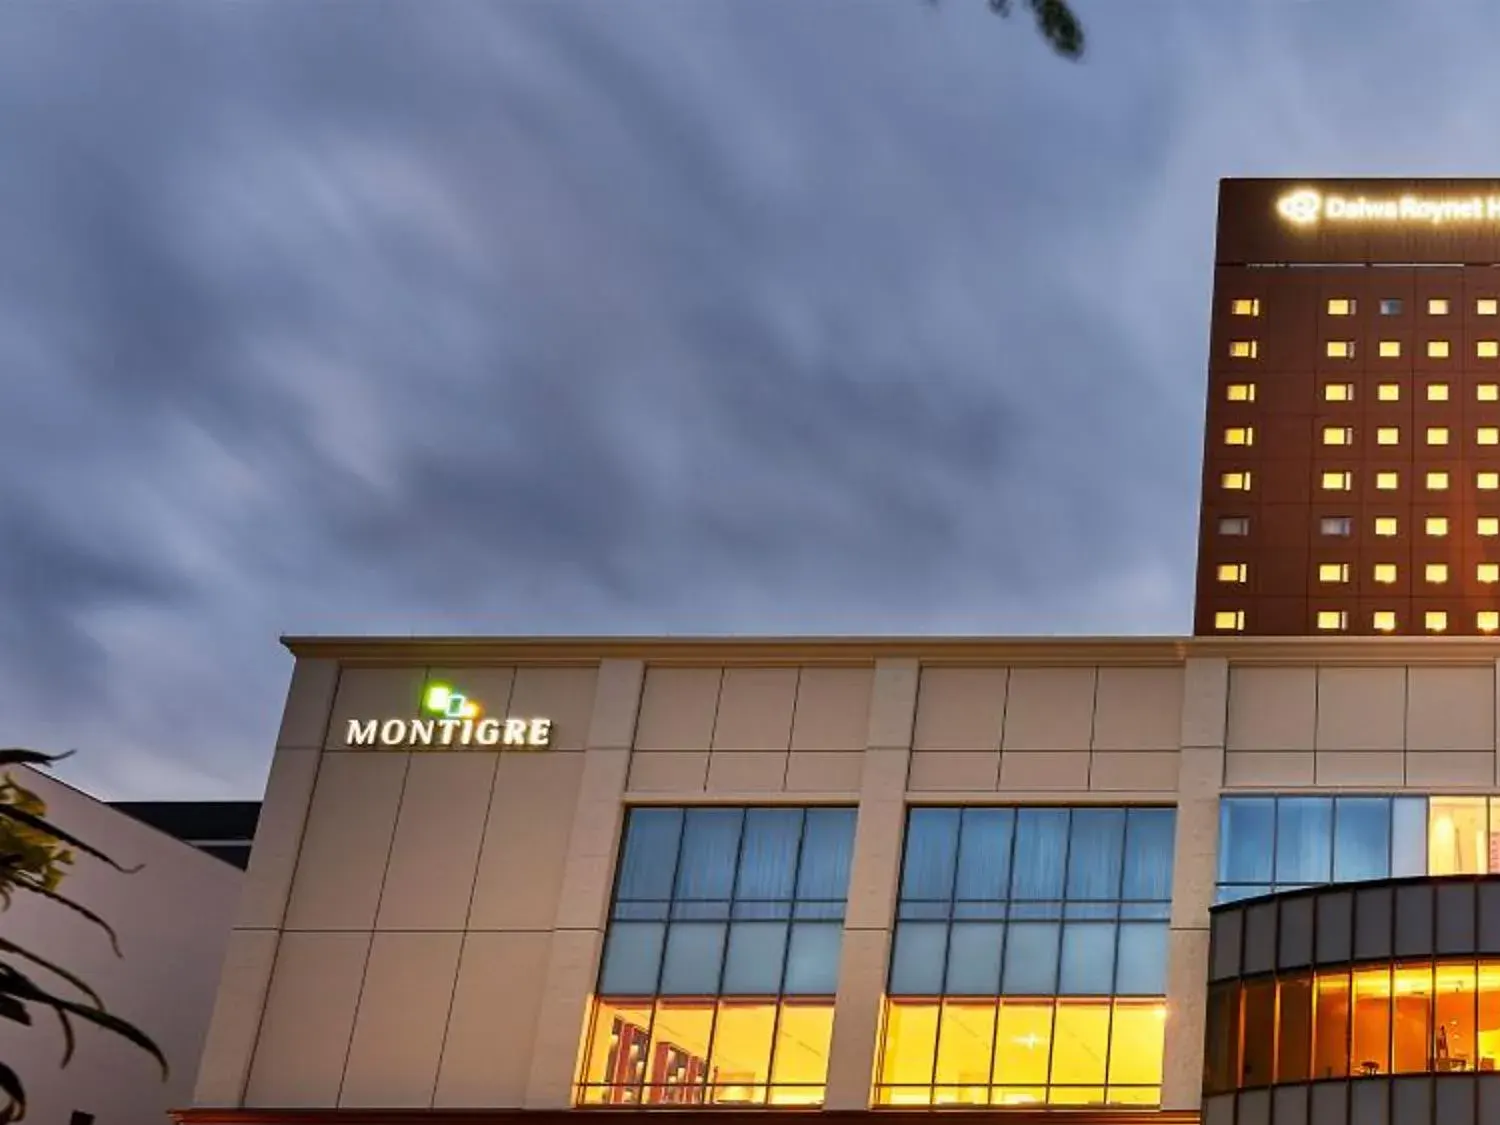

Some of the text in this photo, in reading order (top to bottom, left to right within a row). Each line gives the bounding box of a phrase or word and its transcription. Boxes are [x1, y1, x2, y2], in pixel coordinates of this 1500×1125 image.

[1326, 197, 1398, 218] Daiwa
[1400, 197, 1482, 221] Roynet
[346, 718, 551, 746] MONTIGRE
